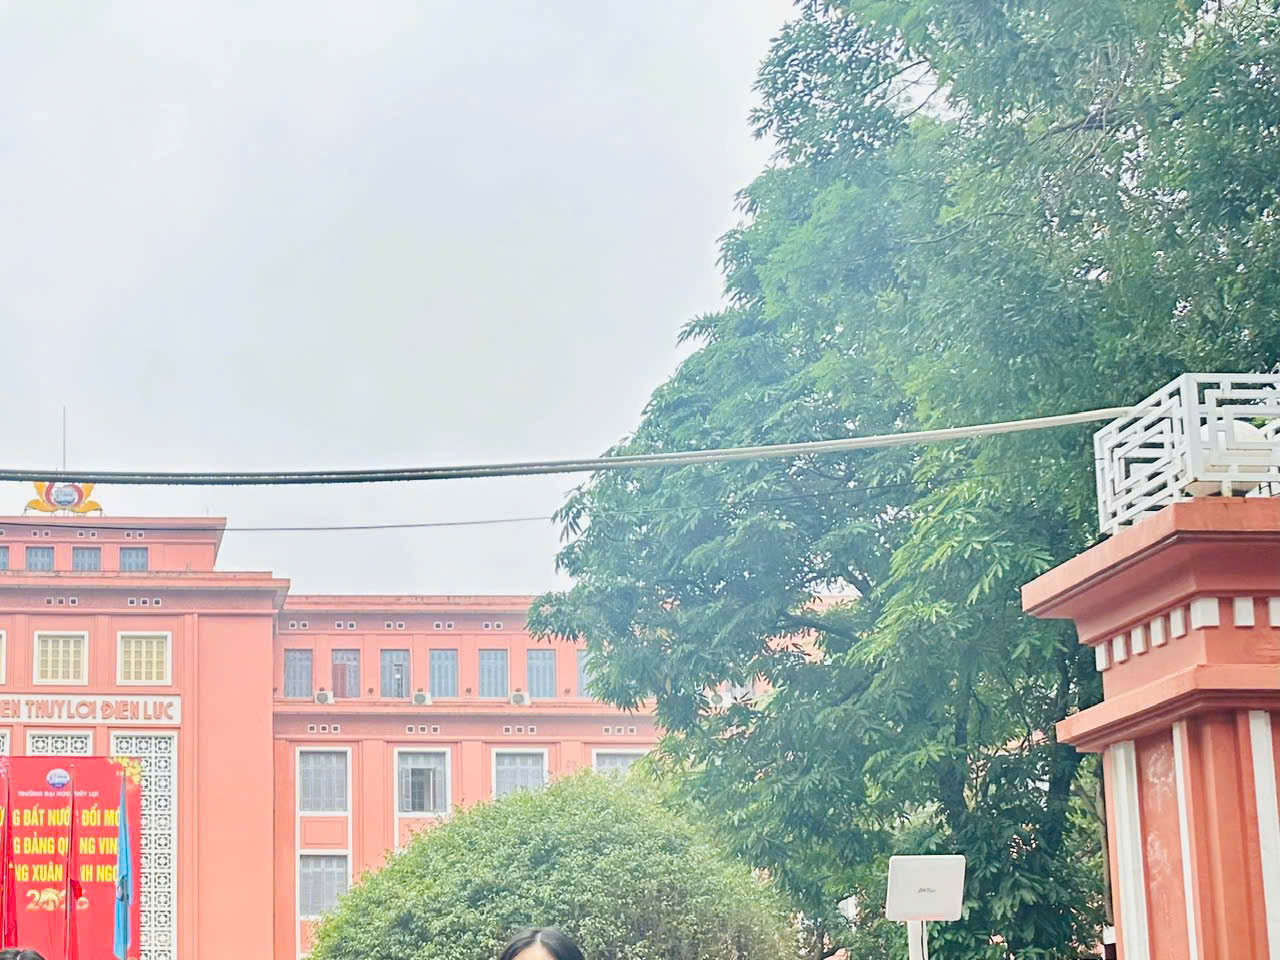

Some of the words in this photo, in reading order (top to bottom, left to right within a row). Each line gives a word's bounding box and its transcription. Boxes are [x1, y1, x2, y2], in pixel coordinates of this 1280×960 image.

[47, 804, 79, 827] NƯỚ
[58, 836, 96, 856] QNG
[99, 836, 119, 855] VIN
[32, 860, 63, 882] XUÂN
